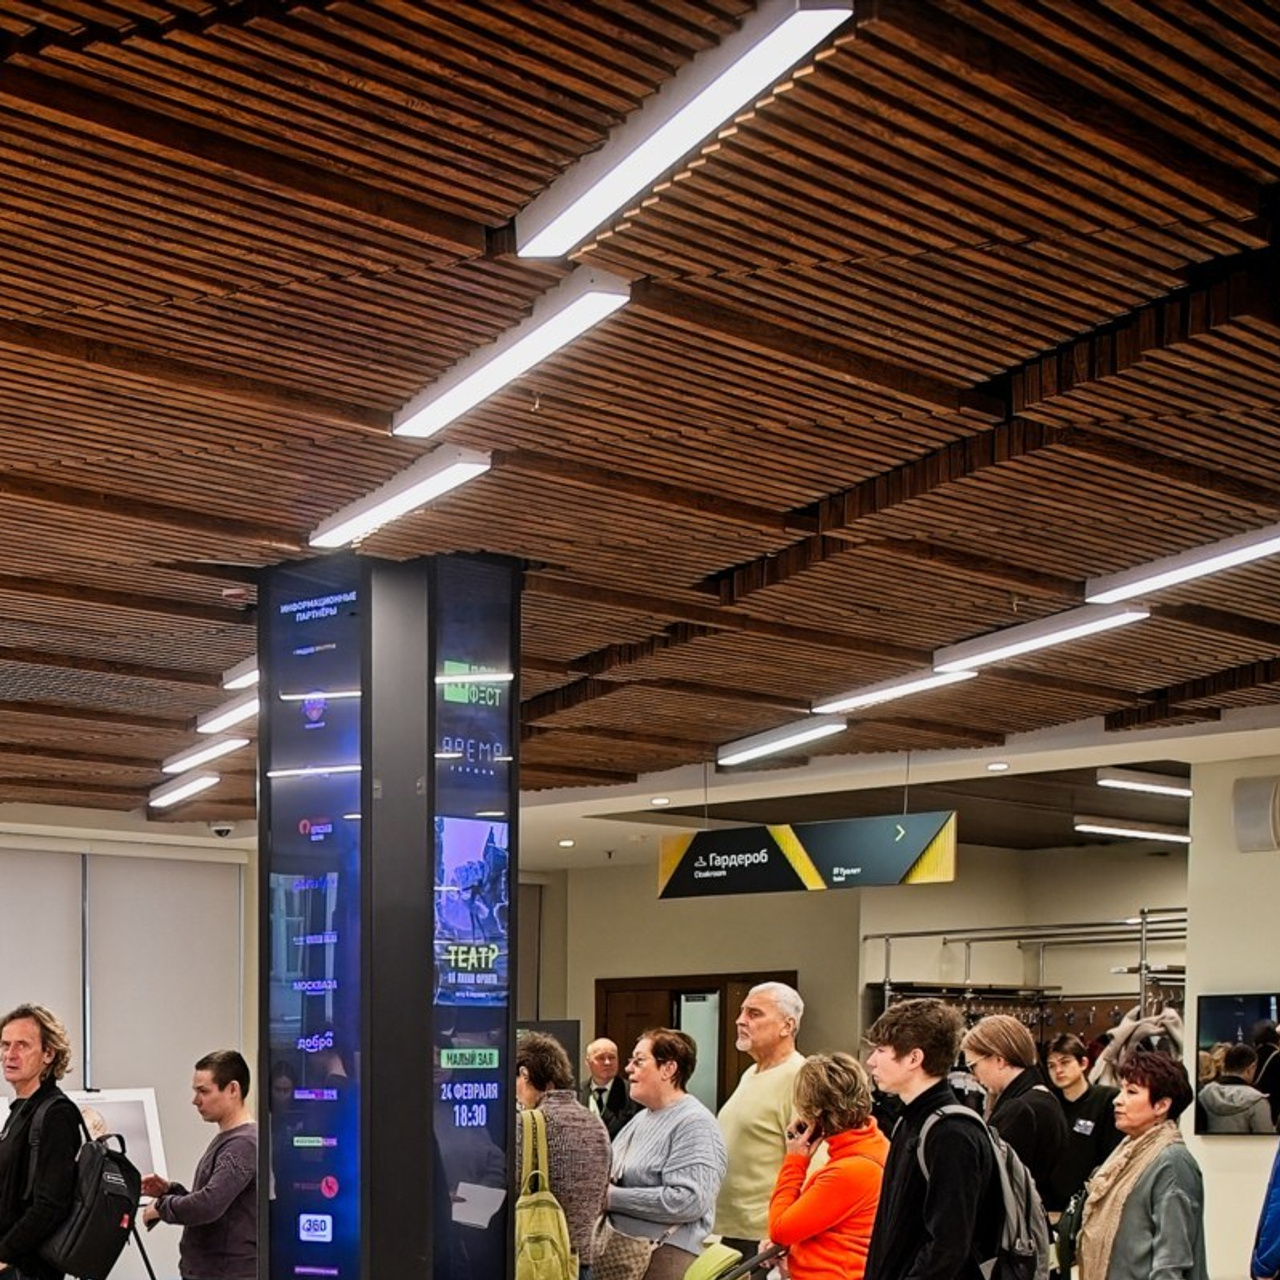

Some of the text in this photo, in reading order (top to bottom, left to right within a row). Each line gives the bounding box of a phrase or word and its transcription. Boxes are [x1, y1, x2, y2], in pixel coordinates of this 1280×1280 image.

[709, 849, 769, 869] Гардероб
[453, 1082, 499, 1100] ФЕВРАЛЯ
[453, 1104, 487, 1127] 18:30
